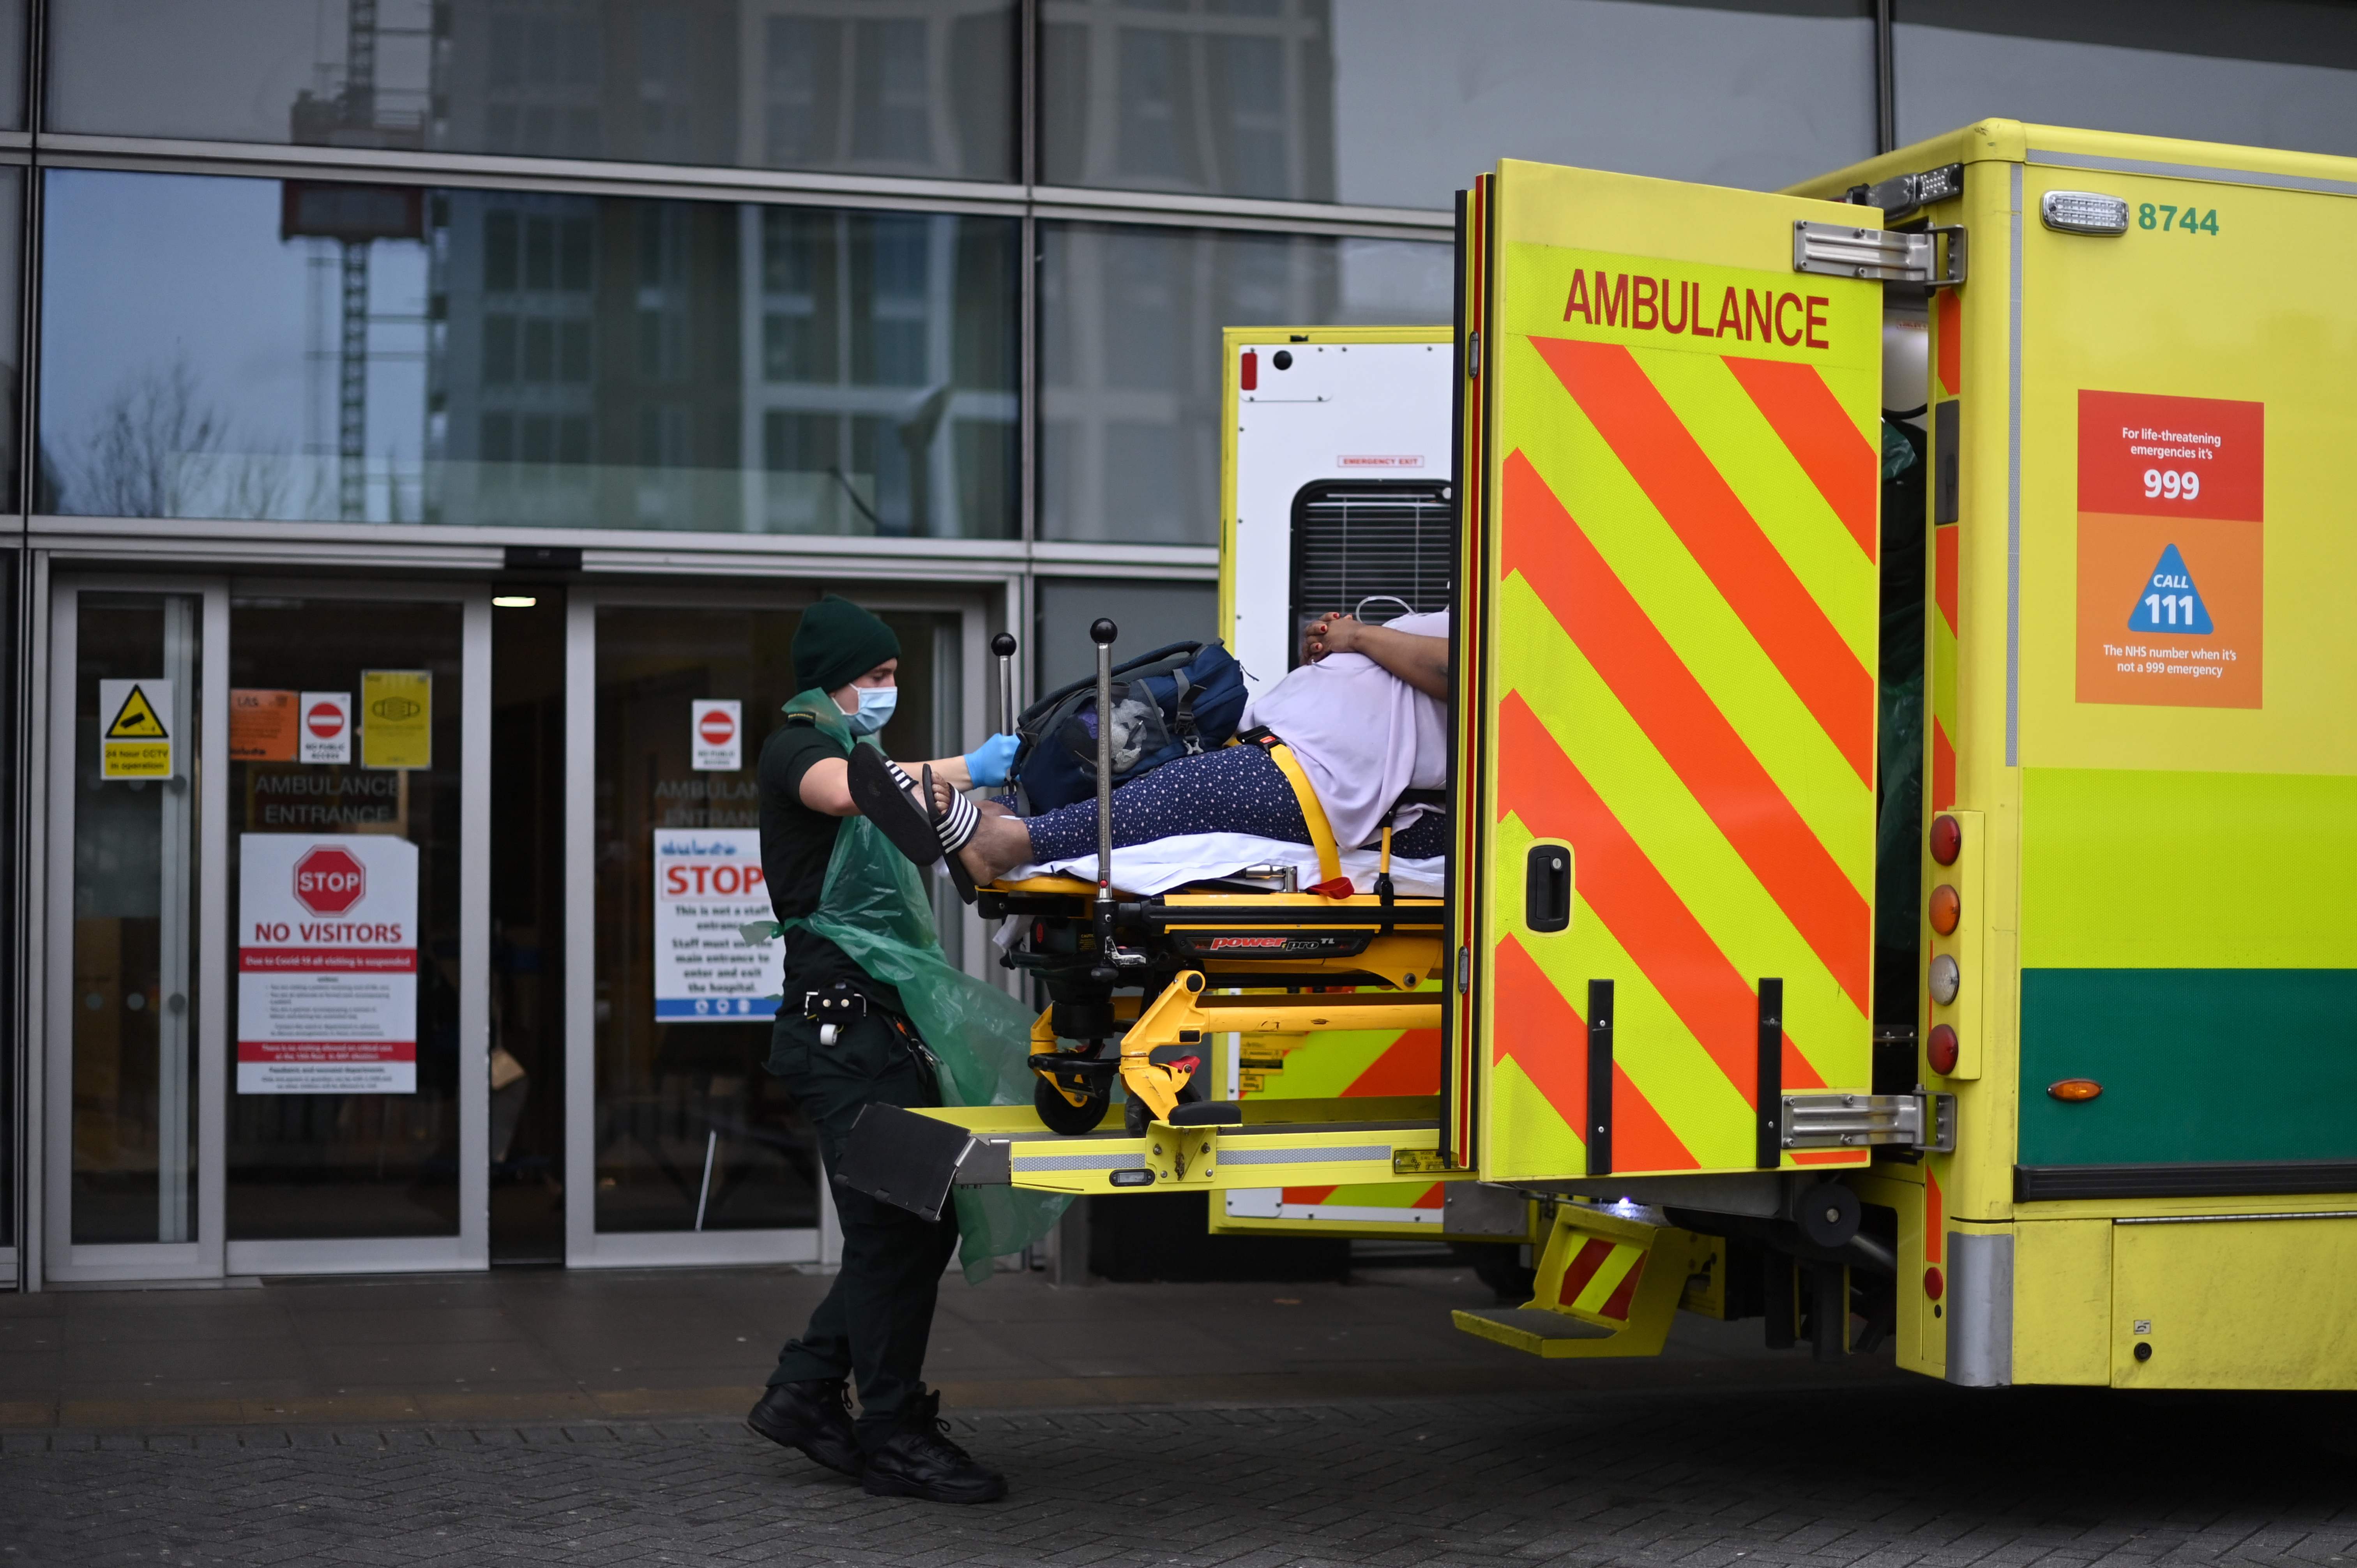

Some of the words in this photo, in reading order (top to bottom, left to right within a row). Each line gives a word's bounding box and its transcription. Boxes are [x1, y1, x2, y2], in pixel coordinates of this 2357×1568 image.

[2138, 203, 2219, 236] 8744
[1563, 268, 1829, 350] AMBULANCE
[2122, 427, 2140, 439] For
[2141, 428, 2221, 447] life-threatening
[2131, 445, 2196, 459] emergencies
[2198, 448, 2213, 459] it's
[2143, 469, 2200, 500] 999
[2153, 574, 2189, 588] CALL
[2145, 594, 2193, 625] 111
[2103, 644, 2123, 657] The
[2125, 646, 2147, 657] NHS
[2149, 647, 2189, 659] number
[2191, 648, 2219, 660] when
[2222, 649, 2237, 661] it's
[2117, 662, 2135, 672] not
[2137, 664, 2143, 673] a
[2146, 662, 2165, 673] 999
[2167, 664, 2223, 678] emergency
[142, 749, 169, 758] CCTV
[255, 775, 399, 796] AMBULANCE
[655, 780, 759, 798] AMBULAN
[265, 804, 389, 824] ENTRANCE
[665, 808, 760, 827] ENTRAN
[299, 871, 360, 892] STOP
[667, 865, 764, 895] STOP
[675, 906, 696, 915] This
[700, 906, 708, 915] is
[713, 906, 730, 915] not
[744, 906, 770, 915] staff
[255, 922, 290, 942] NO
[300, 922, 402, 943] VISITORS
[673, 938, 699, 948] Staff
[703, 939, 730, 948] must
[684, 969, 712, 977] enter
[717, 968, 737, 977] and
[741, 968, 761, 977] exit
[688, 983, 705, 992] the
